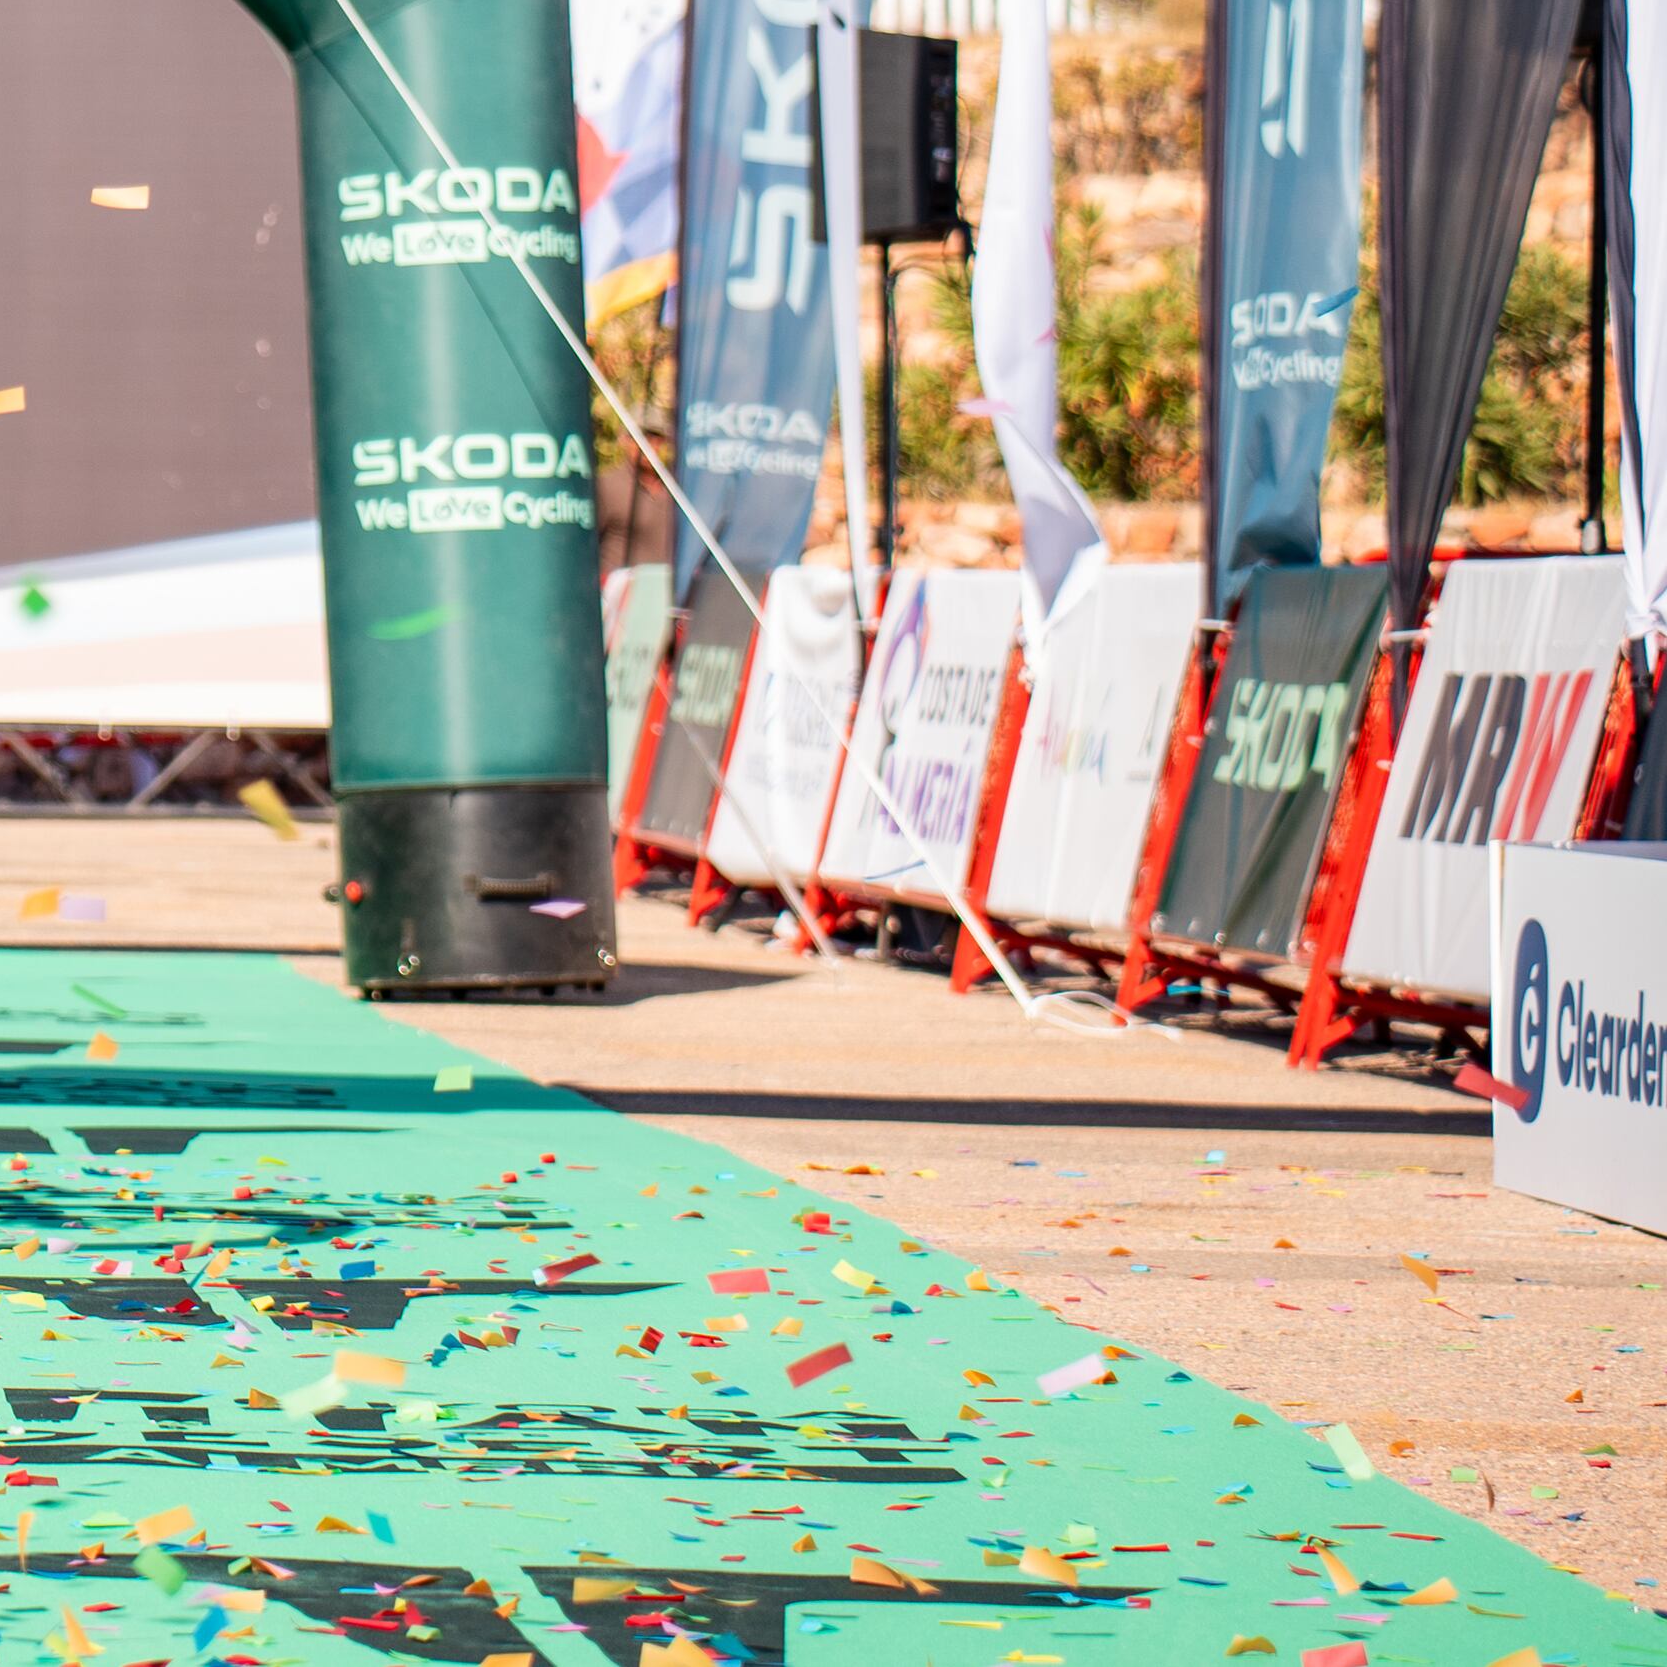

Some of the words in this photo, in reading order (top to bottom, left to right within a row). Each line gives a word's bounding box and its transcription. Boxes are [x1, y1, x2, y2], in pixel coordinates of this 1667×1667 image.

[338, 166, 578, 222] SKODA
[341, 234, 394, 266] We
[352, 432, 593, 486] SKODA
[355, 499, 408, 531] We
[503, 491, 595, 530] Cycling
